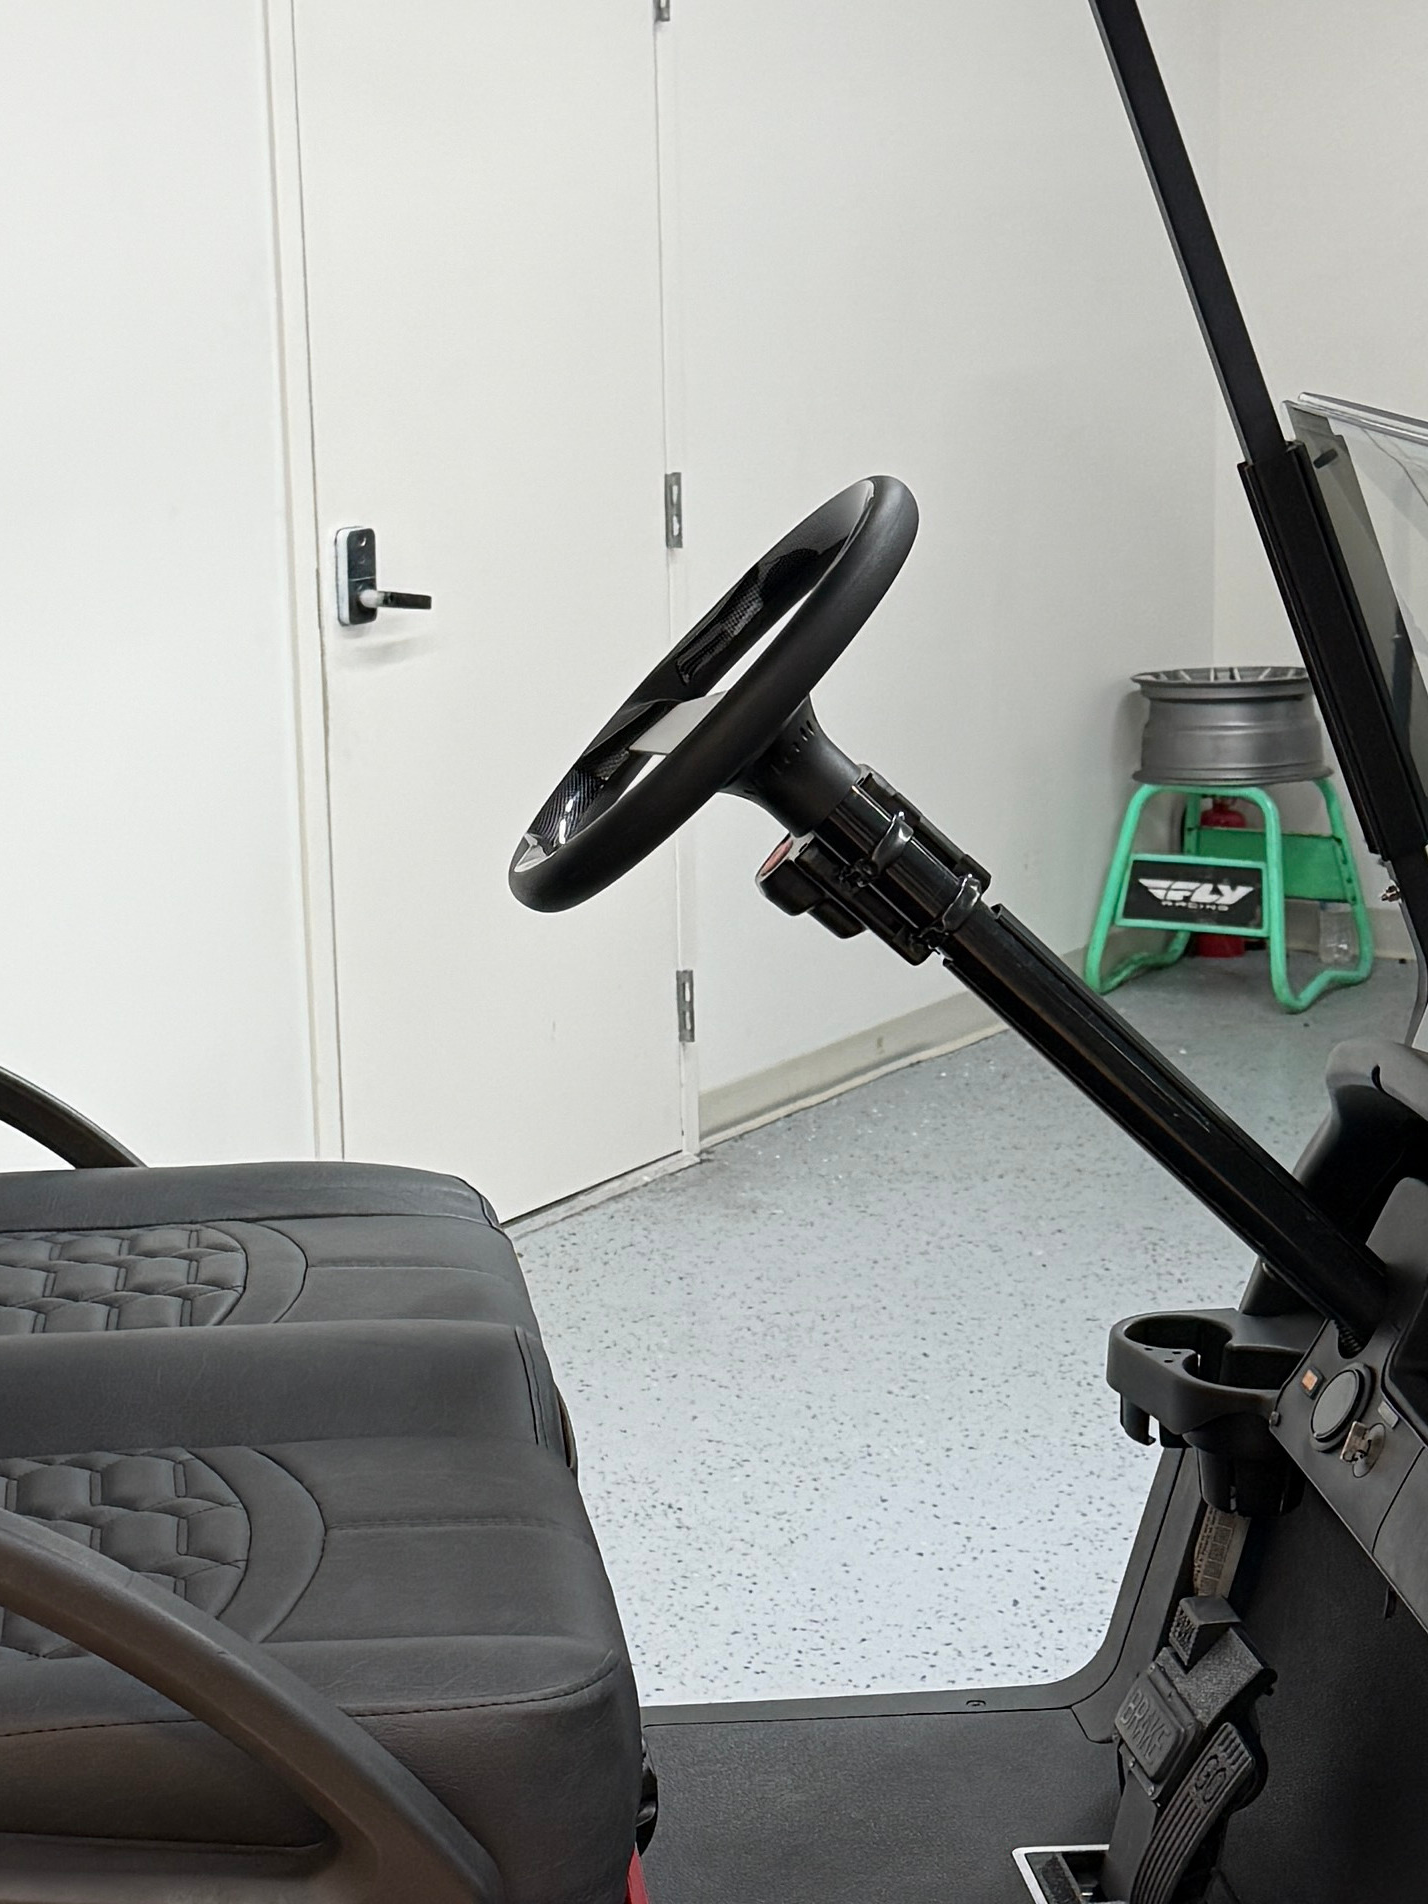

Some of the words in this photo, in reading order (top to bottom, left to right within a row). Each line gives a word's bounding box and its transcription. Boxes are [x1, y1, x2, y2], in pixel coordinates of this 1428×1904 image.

[1139, 878, 1254, 905] FLY
[1120, 1689, 1172, 1762] BRAKE
[1193, 1753, 1229, 1804] GO
